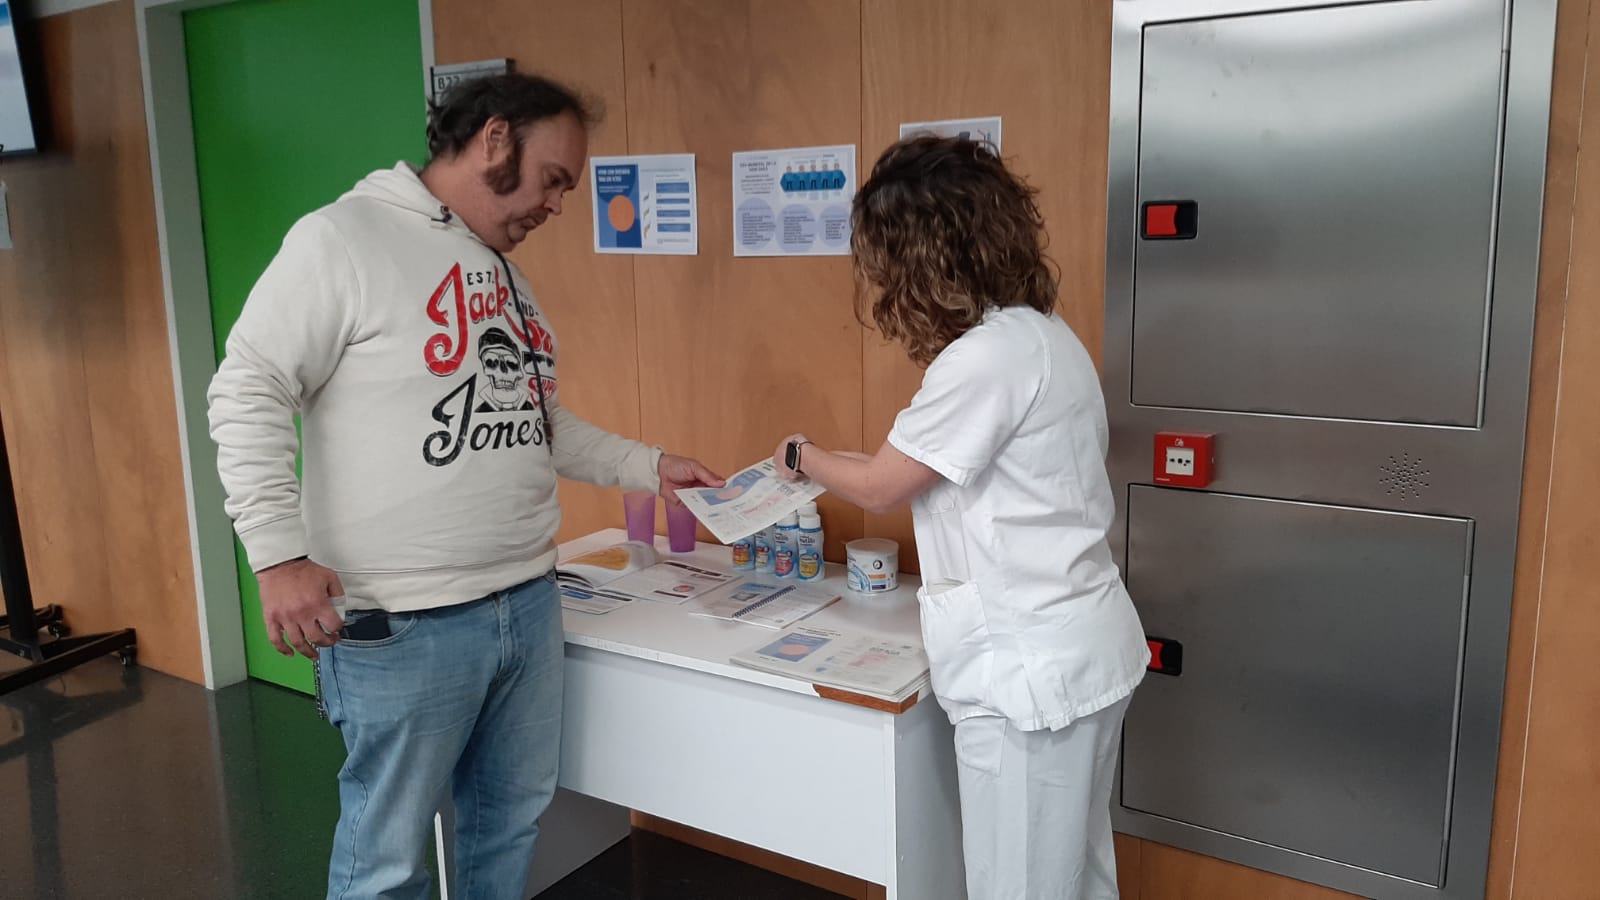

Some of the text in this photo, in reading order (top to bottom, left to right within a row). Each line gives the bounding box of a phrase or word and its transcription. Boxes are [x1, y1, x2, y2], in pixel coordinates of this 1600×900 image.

[423, 262, 522, 377] Jack
[467, 271, 494, 286] EST.
[422, 373, 544, 467] Jones
